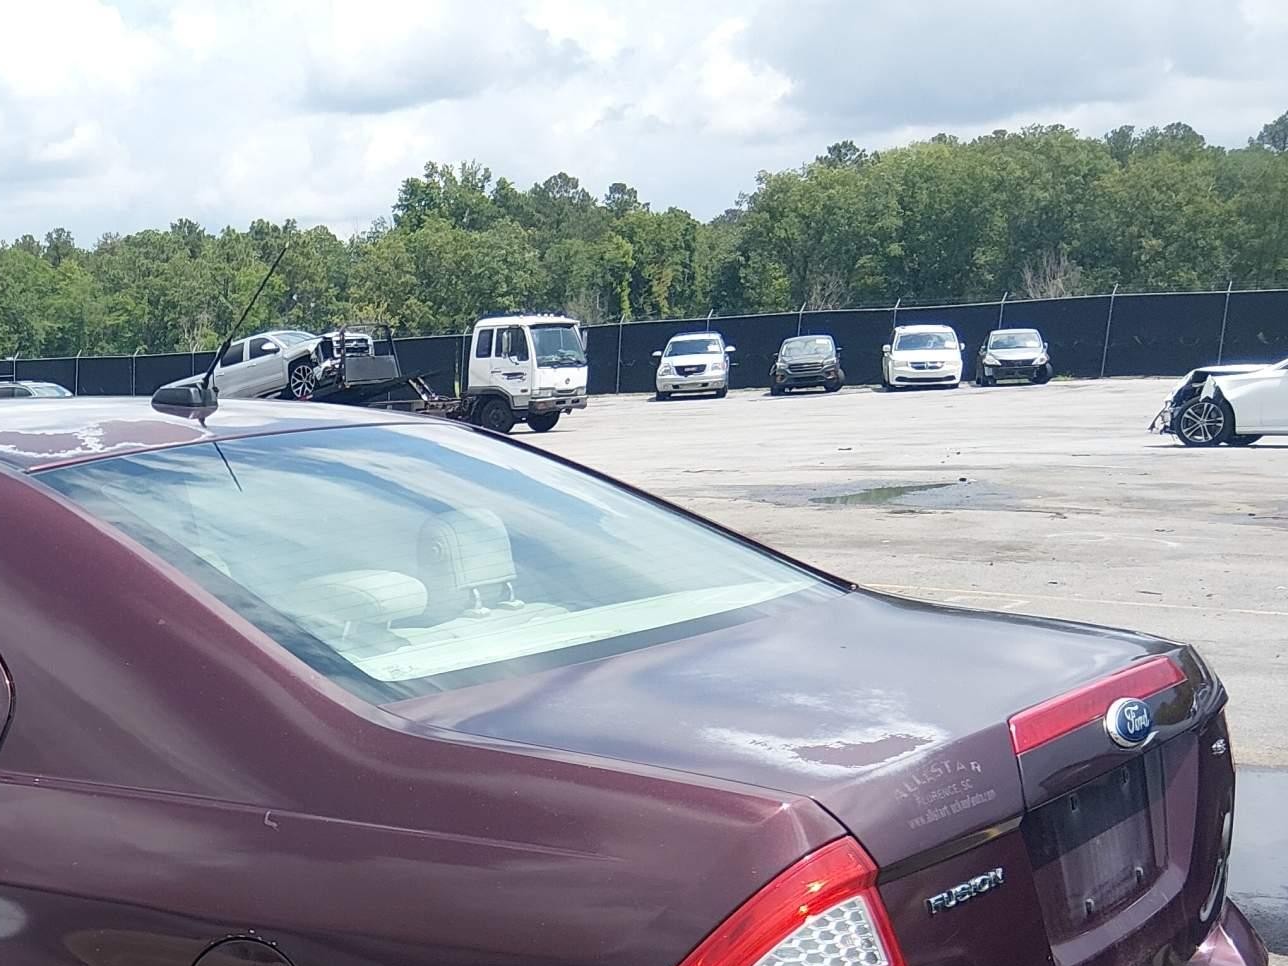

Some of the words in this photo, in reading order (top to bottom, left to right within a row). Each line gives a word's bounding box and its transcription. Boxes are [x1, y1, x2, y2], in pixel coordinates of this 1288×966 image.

[1124, 704, 1150, 734] Ford
[961, 778, 973, 792] SC
[924, 867, 1005, 914] FUSION
